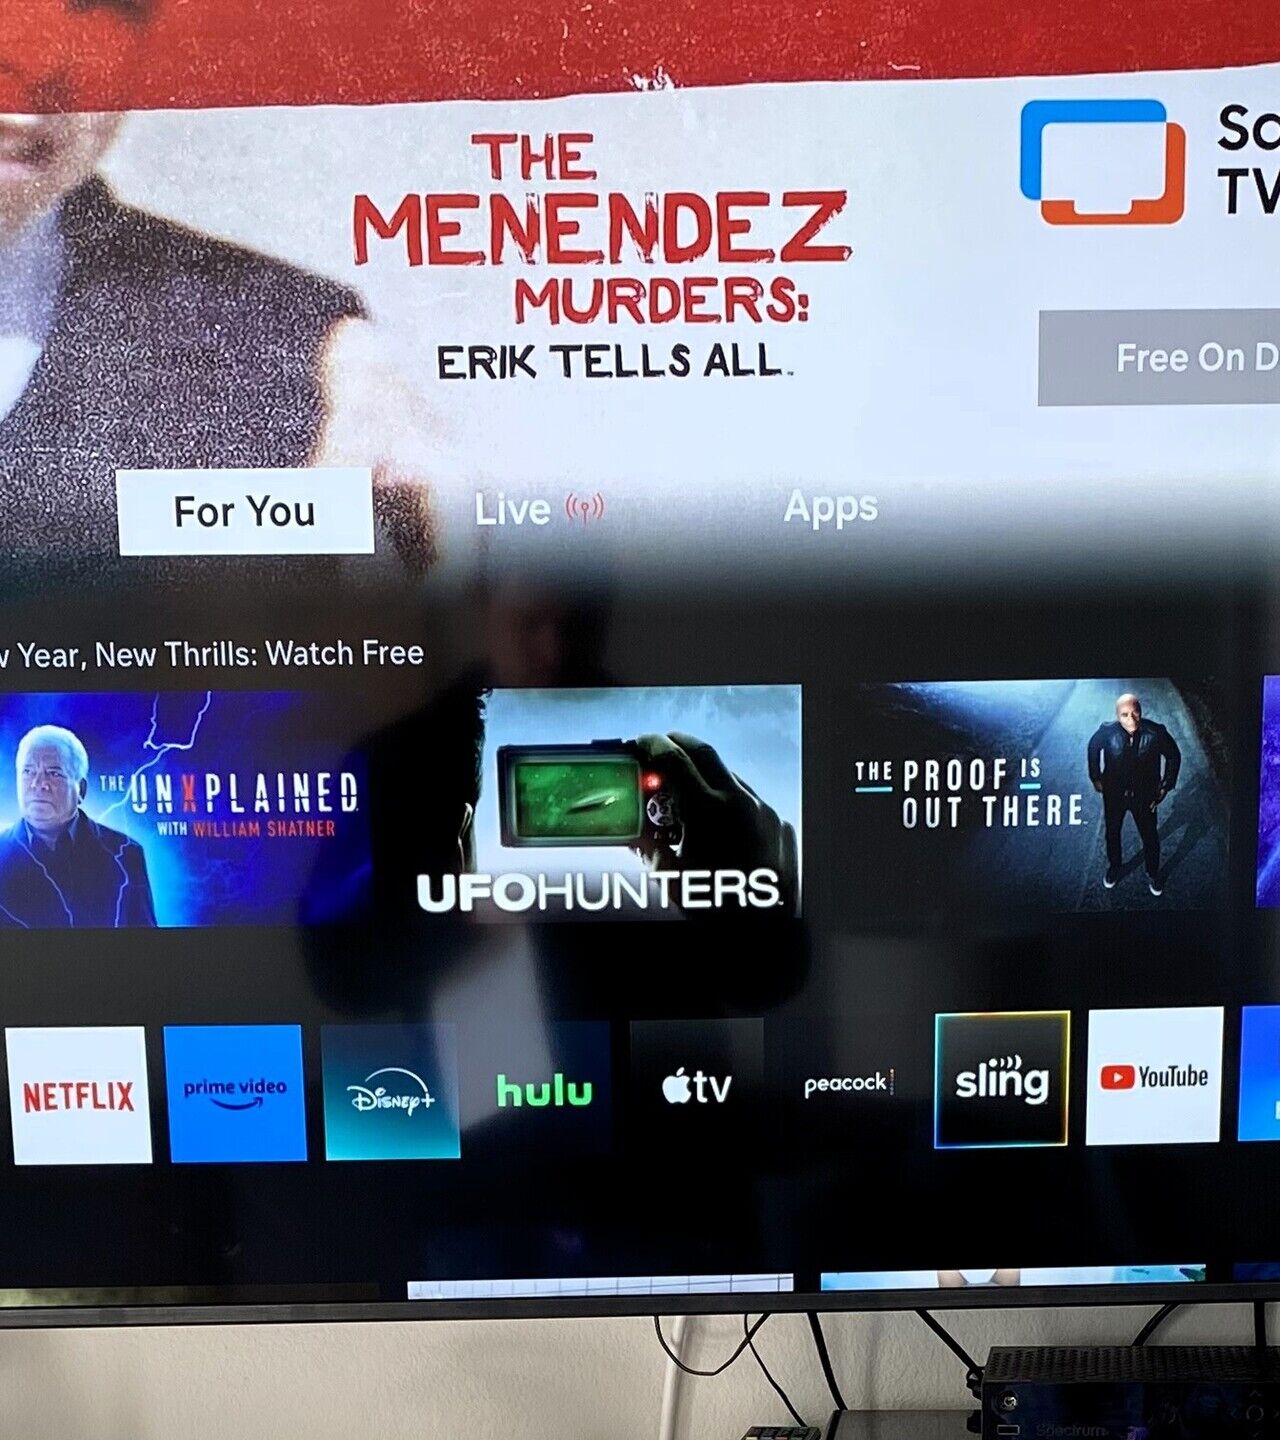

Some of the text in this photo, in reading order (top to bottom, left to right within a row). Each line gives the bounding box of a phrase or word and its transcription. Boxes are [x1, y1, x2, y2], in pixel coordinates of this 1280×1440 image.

[472, 133, 596, 180] THE
[354, 190, 852, 266] MENENDEZ
[515, 277, 809, 325] MURDERS:
[437, 342, 782, 380] ERIK TELLS ALL
[1116, 342, 1188, 372] Free
[1198, 341, 1245, 371] On
[174, 495, 315, 528] For You
[475, 493, 551, 525] Live
[783, 489, 879, 530] Apps
[17, 642, 87, 671] Year,
[95, 641, 156, 667] New
[165, 640, 258, 667] Thrills:
[265, 640, 354, 666] Watch
[363, 639, 424, 665] Free
[855, 757, 1041, 791] THE PROOF IS
[100, 772, 357, 813] THE UNXPLAINED
[157, 820, 336, 837] WITH WILLIAM SHATNER
[902, 796, 1084, 829] OUT THERE
[183, 1078, 288, 1098] prime video
[497, 1073, 592, 1108] hulu
[694, 1070, 732, 1103] tv
[804, 1072, 887, 1099] peacock
[955, 1061, 1050, 1105] sling
[1139, 1065, 1208, 1088] YouTube
[23, 1082, 134, 1113] NETFLIX
